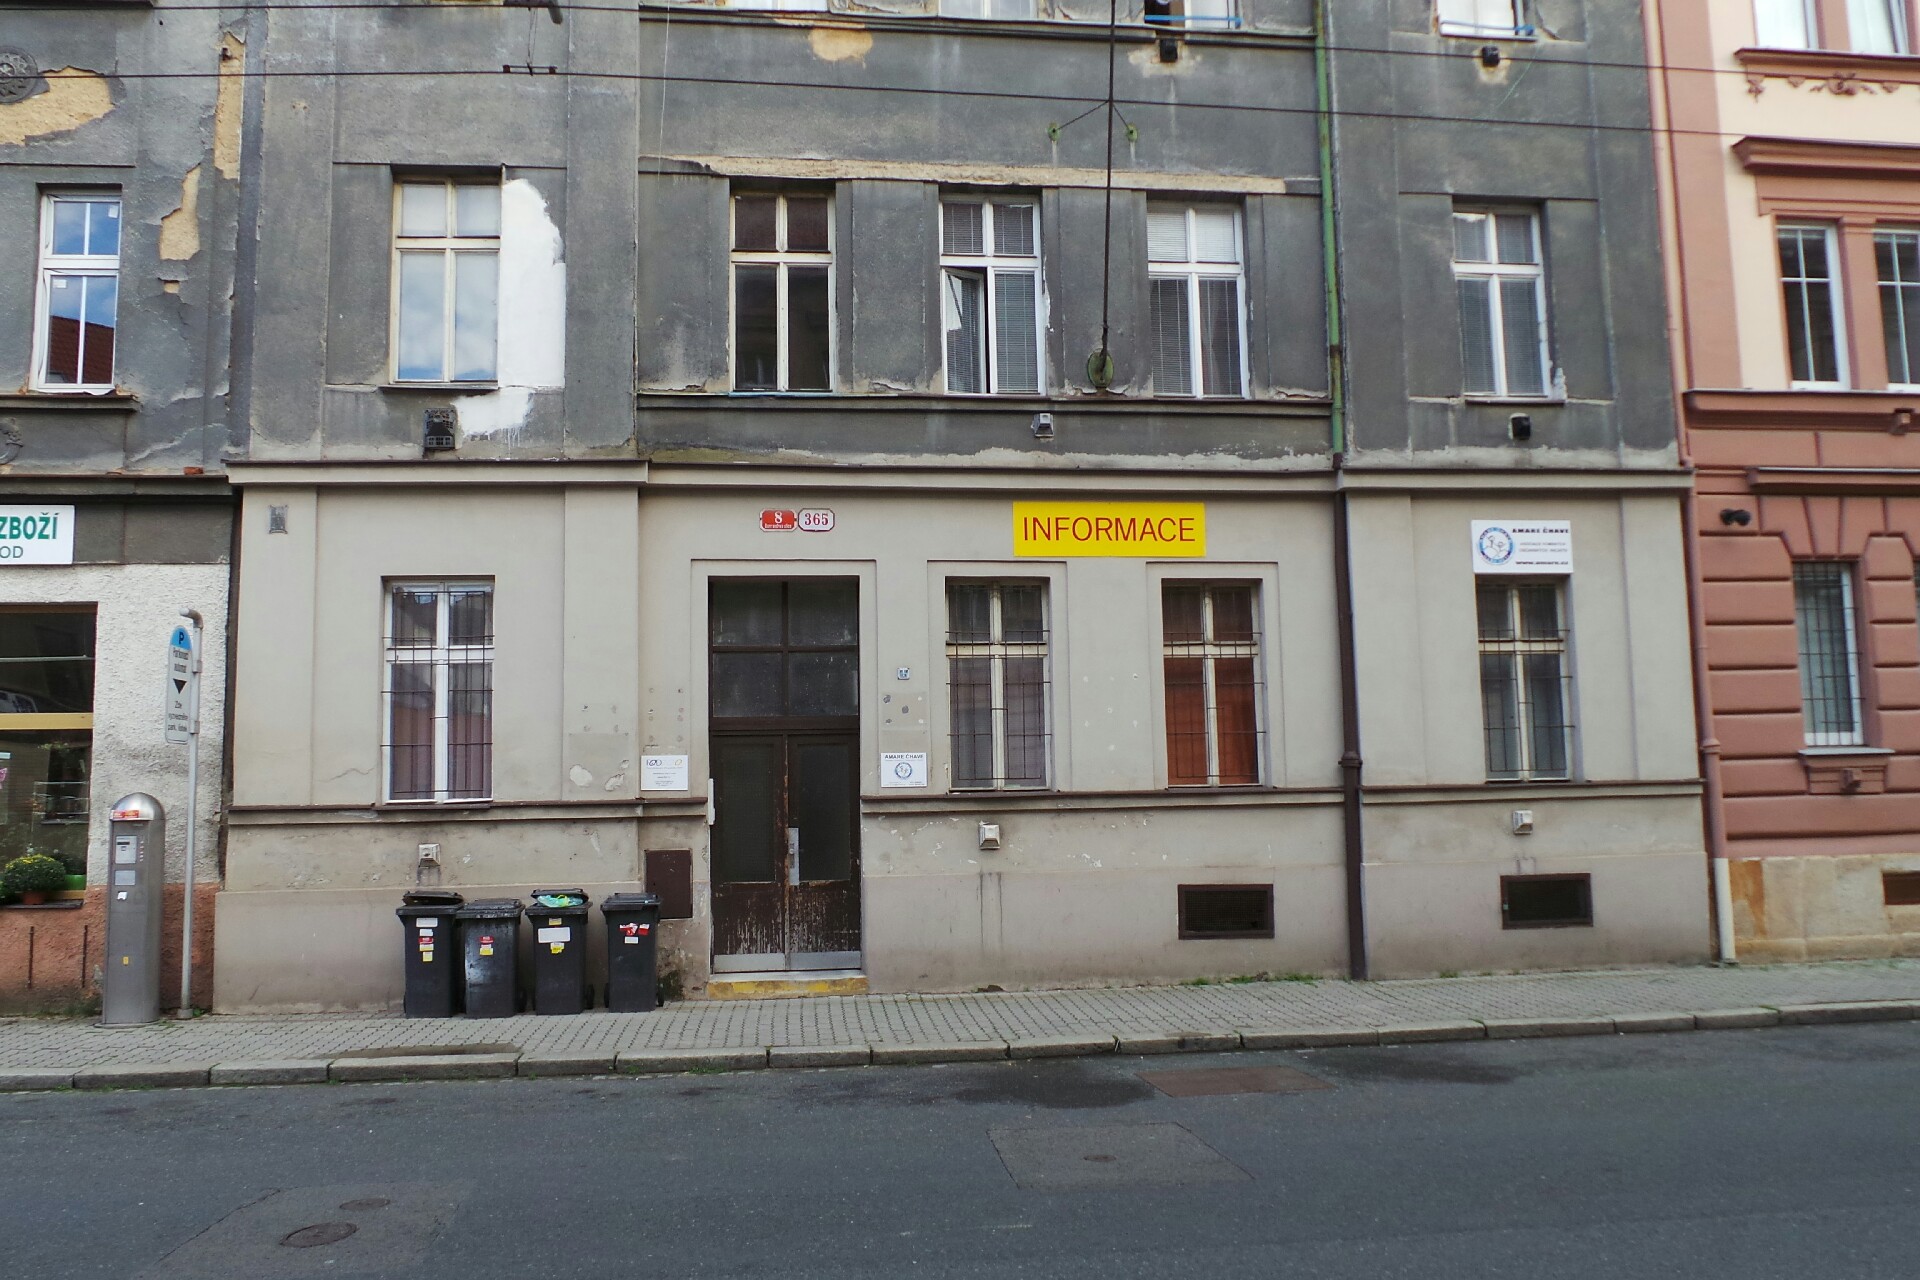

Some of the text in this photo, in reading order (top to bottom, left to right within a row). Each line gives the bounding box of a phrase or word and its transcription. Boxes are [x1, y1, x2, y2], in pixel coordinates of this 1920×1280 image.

[774, 510, 783, 524] 8
[804, 512, 829, 526] 365
[0, 511, 60, 540] ZBOŽÍ
[1023, 516, 1196, 542] INFORMACE
[178, 631, 185, 645] P
